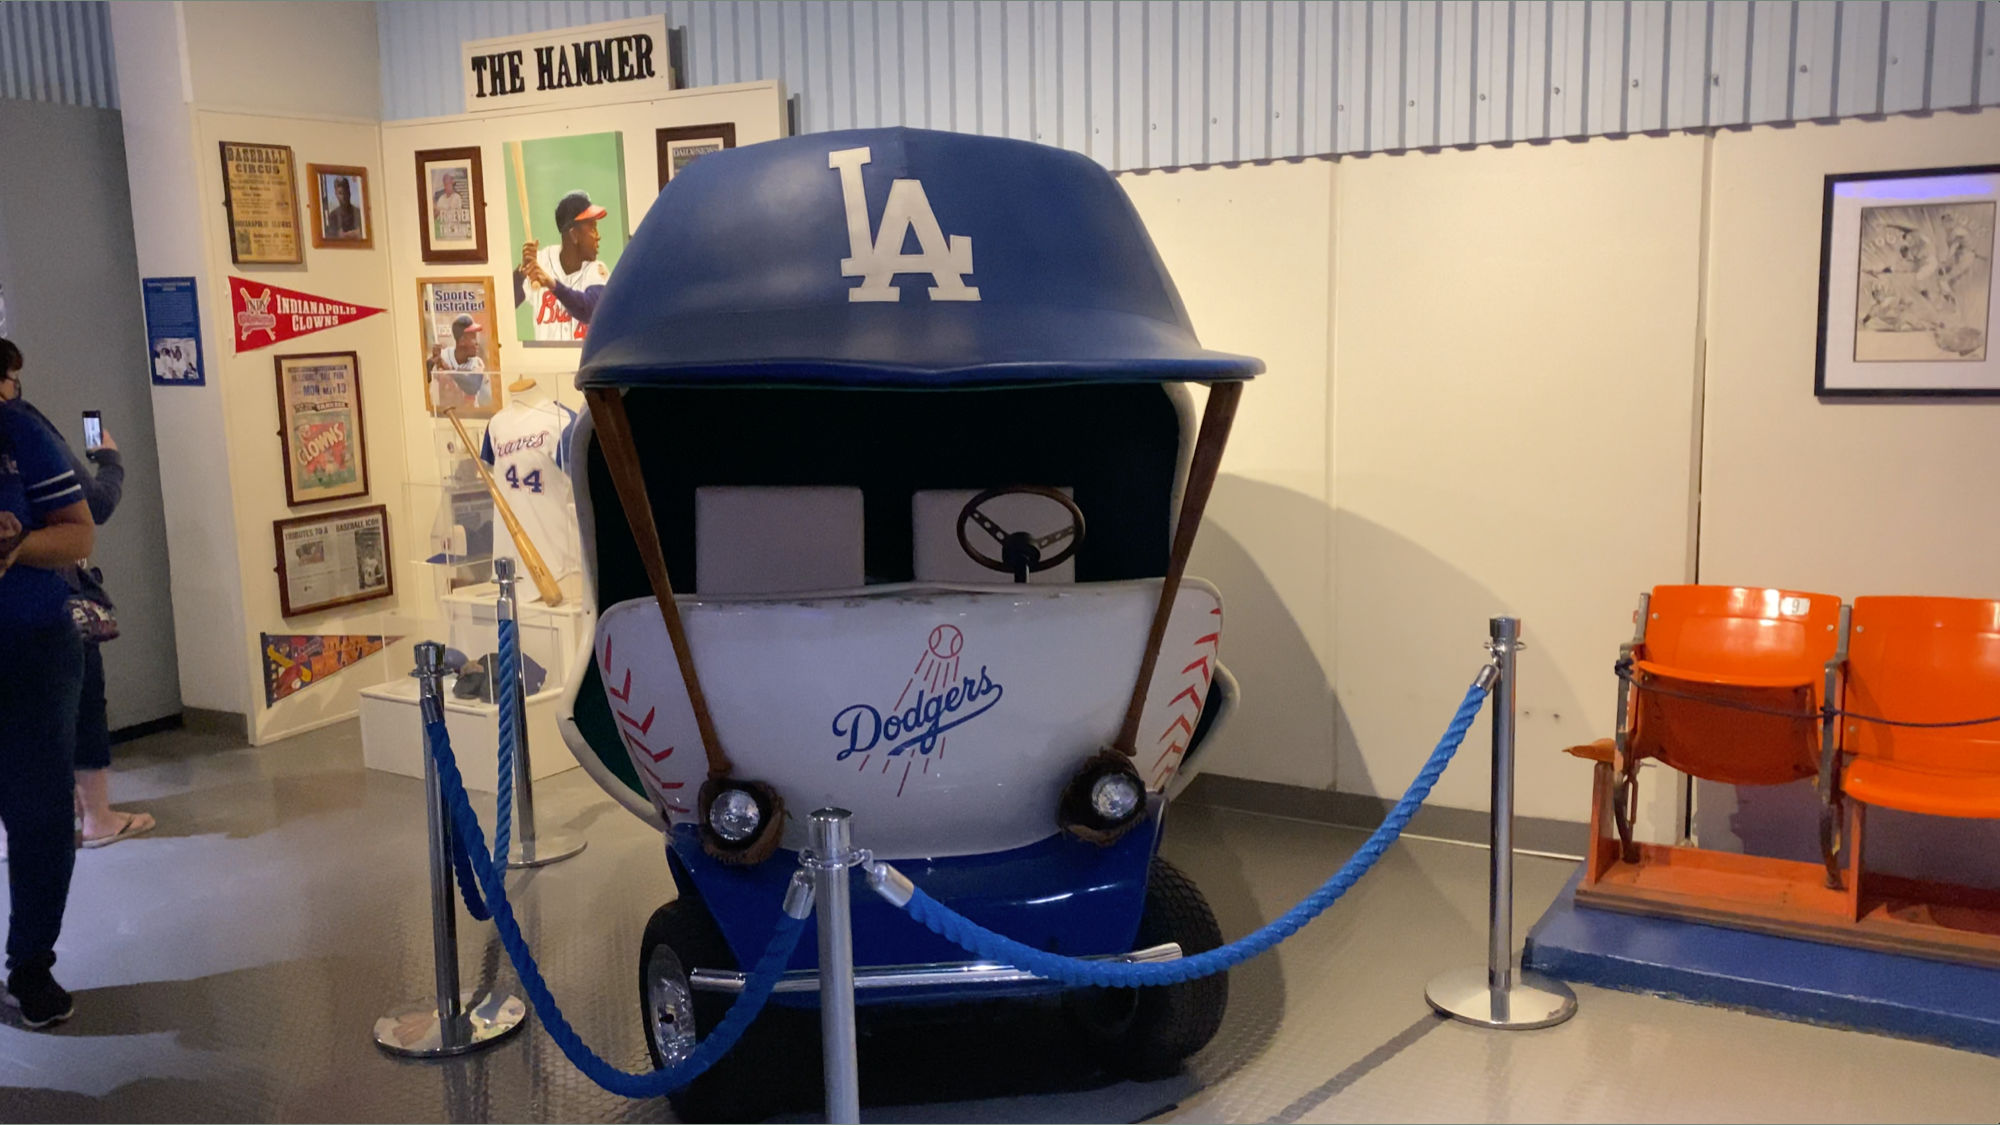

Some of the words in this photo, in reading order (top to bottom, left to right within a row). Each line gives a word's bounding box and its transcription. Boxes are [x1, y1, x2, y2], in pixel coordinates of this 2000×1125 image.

[471, 50, 525, 97] THE
[534, 34, 655, 91] HAMMER
[226, 147, 285, 164] BASEBALL
[235, 164, 280, 174] CIRCUS
[829, 147, 981, 302] LA
[276, 294, 357, 315] INDIANAPOLIS
[434, 290, 475, 302] Sports
[292, 315, 339, 332] CLOWNS
[298, 423, 344, 465] CLOWNS
[494, 431, 549, 457] raves
[505, 464, 543, 494] 44
[1791, 599, 1800, 614] 9
[832, 665, 1003, 761] Dodgers
